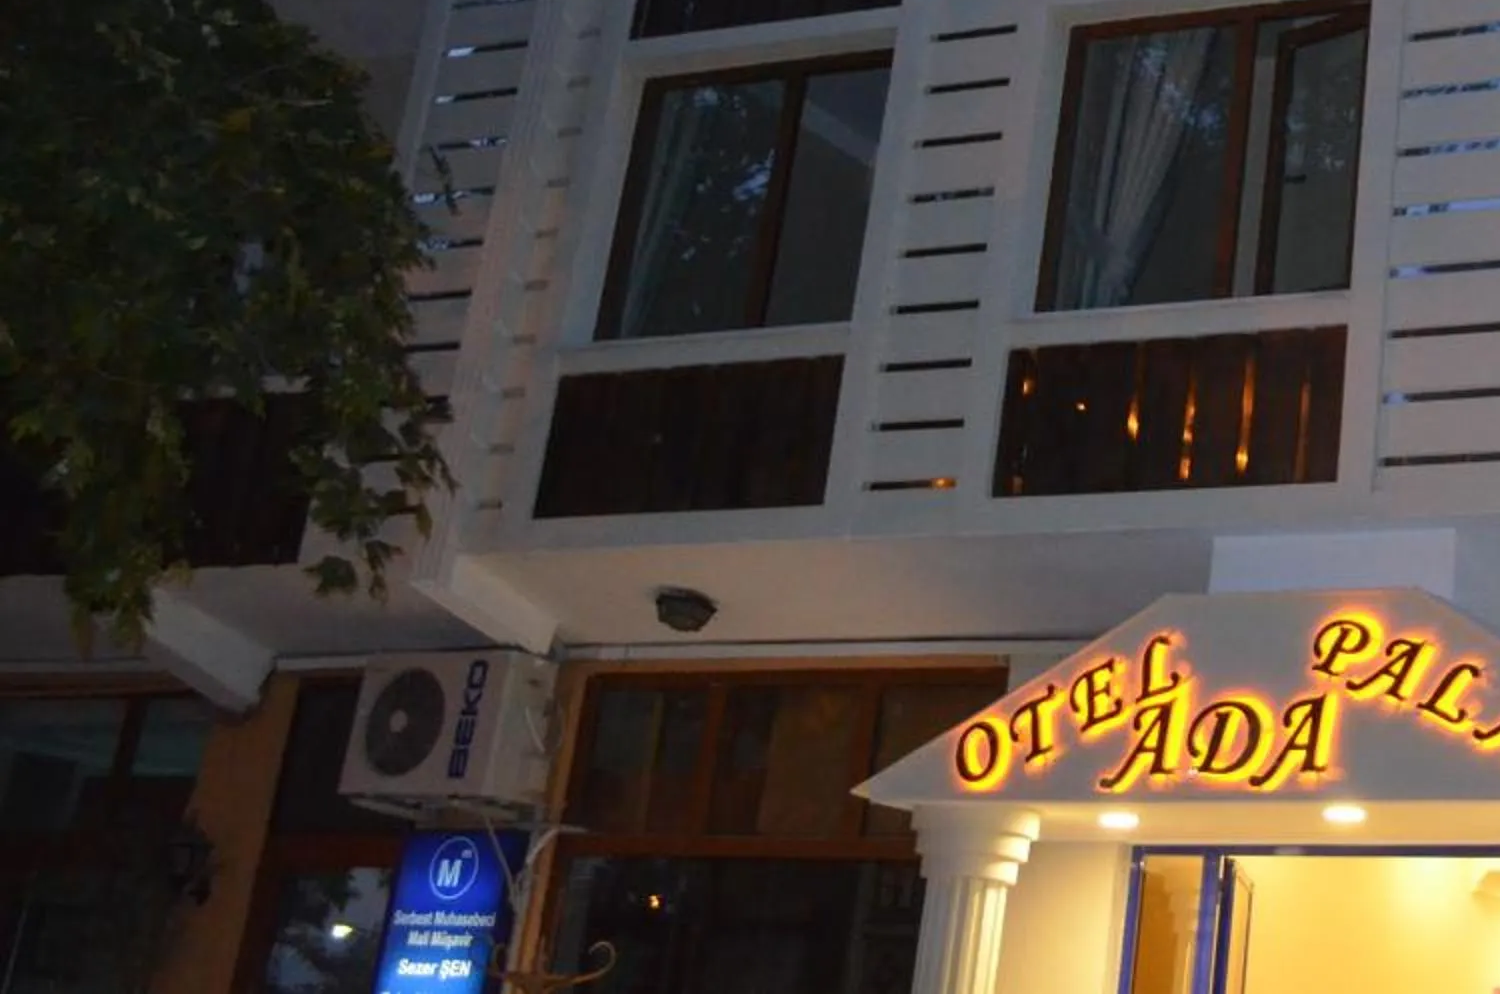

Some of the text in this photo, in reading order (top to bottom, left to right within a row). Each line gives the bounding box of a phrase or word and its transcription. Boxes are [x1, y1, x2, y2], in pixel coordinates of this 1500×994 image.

[447, 659, 489, 779] BEKO
[956, 634, 1183, 784] OTEL
[1099, 694, 1332, 790] ADA
[437, 859, 463, 887] M
[398, 957, 473, 980] Sezer ŞEN
